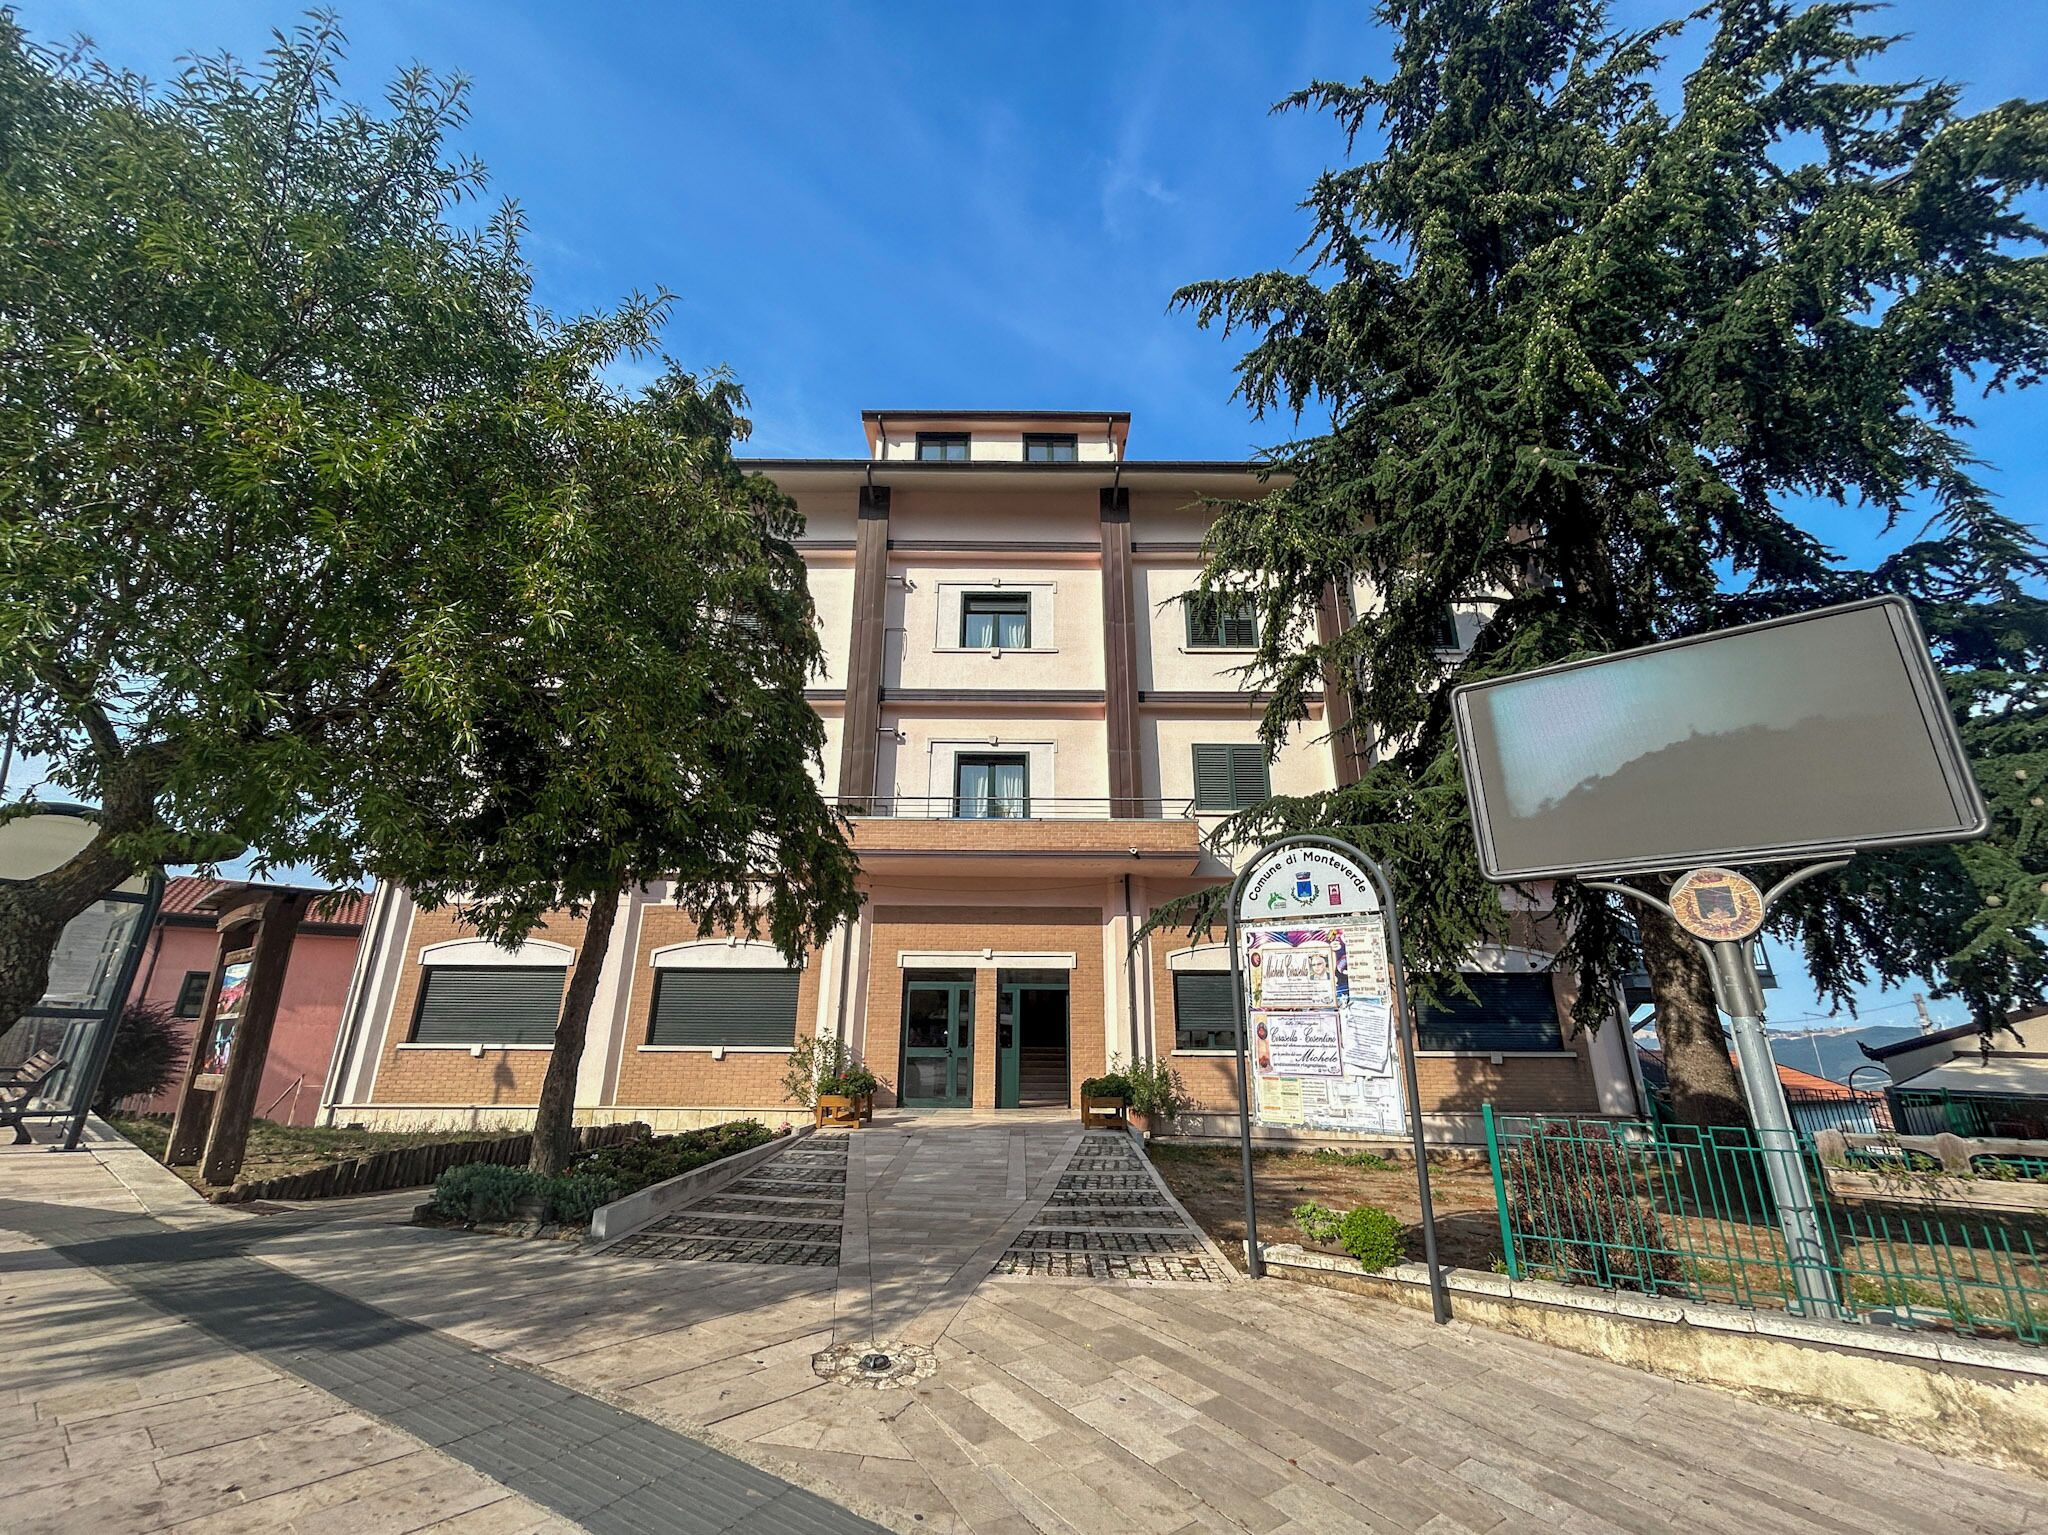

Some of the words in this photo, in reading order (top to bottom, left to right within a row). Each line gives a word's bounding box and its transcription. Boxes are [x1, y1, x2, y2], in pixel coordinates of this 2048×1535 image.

[1248, 862, 1282, 901] Comune
[1286, 854, 1297, 865] di
[1303, 852, 1367, 893] Monteverde
[1295, 1048, 1338, 1063] Michele
